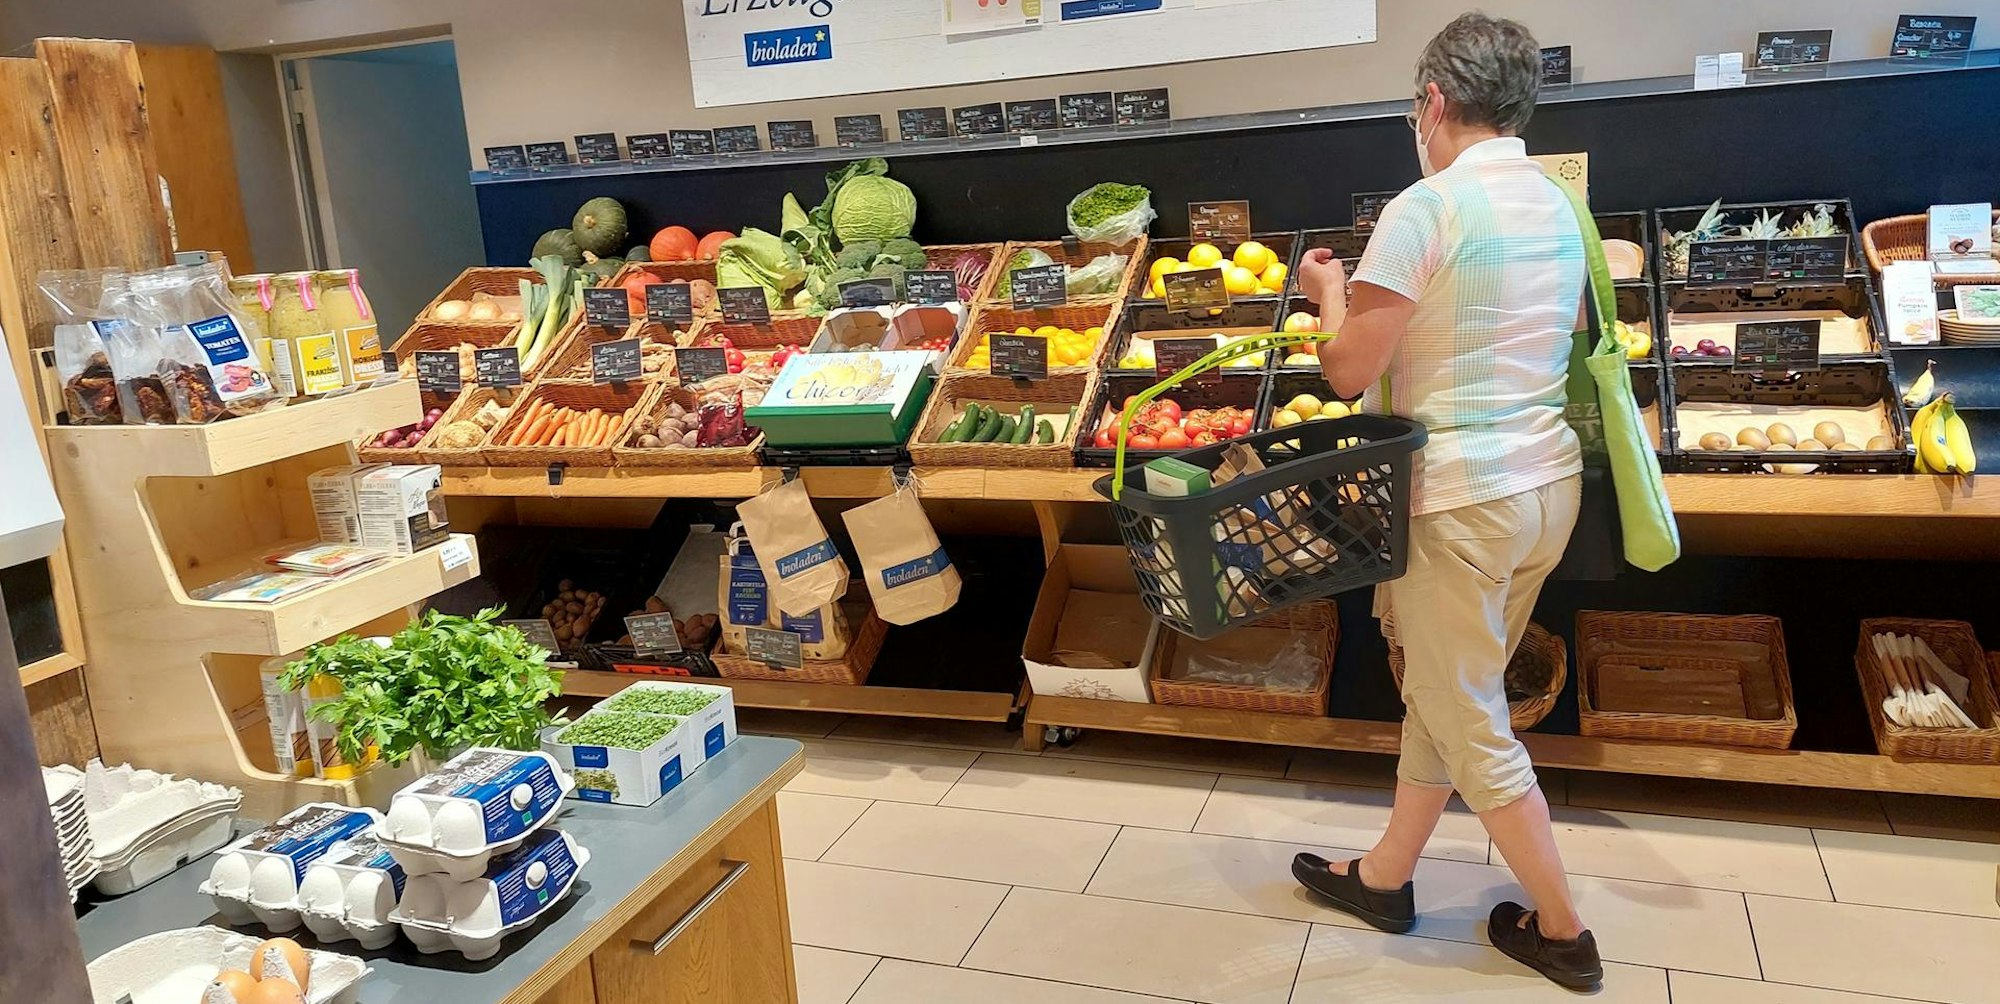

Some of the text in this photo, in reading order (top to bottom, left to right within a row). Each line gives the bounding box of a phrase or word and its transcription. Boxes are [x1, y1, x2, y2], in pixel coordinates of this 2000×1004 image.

[752, 36, 817, 62] bioladen
[203, 336, 242, 350] TOMATEN
[781, 552, 822, 575] bioladen
[886, 565, 929, 586] bioladen
